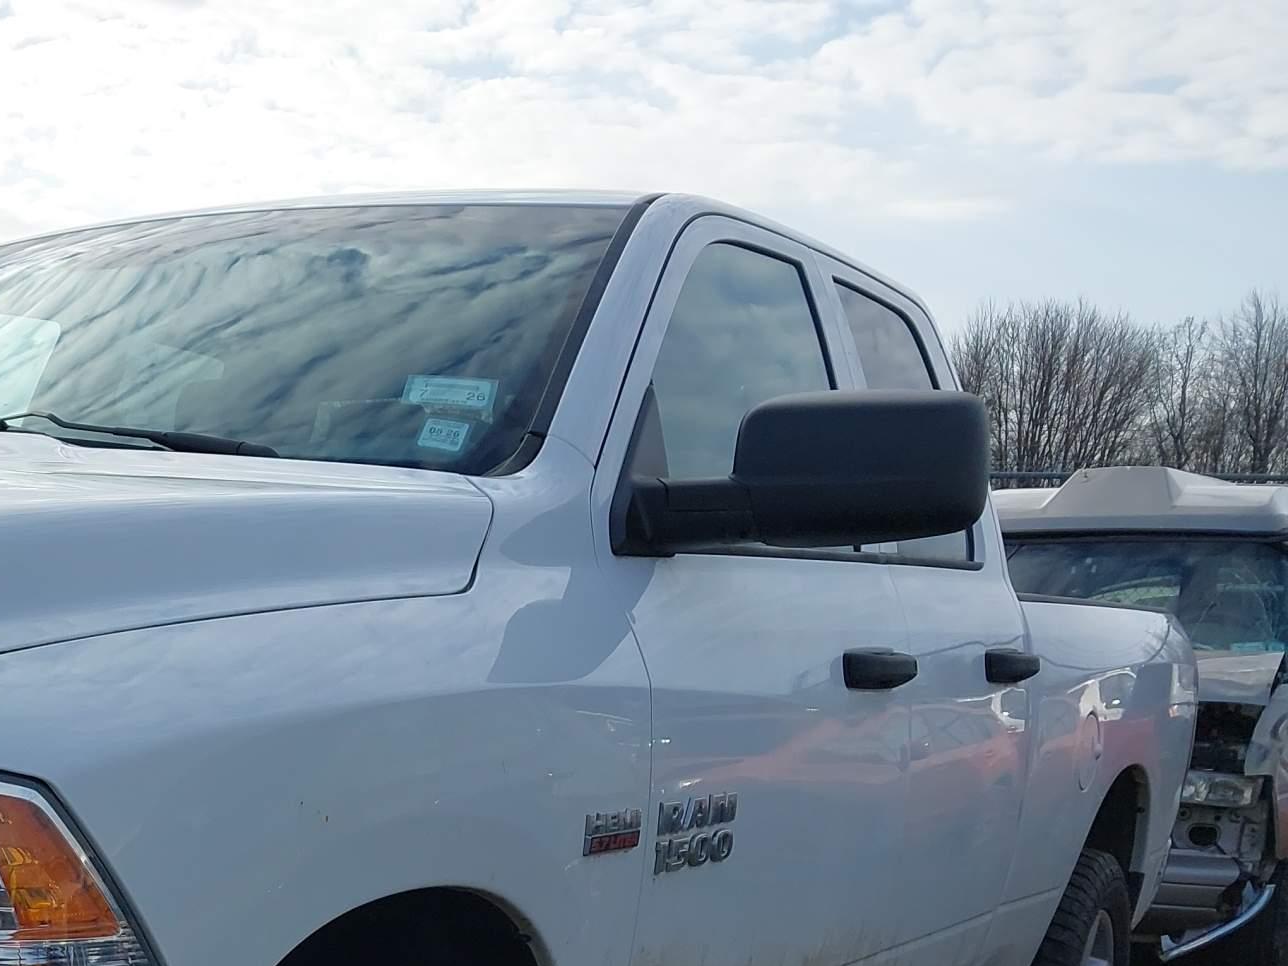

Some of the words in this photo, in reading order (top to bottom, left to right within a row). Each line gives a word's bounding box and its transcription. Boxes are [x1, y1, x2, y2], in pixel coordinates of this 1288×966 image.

[584, 808, 642, 836] HEMI
[656, 792, 738, 836] RAM
[654, 828, 733, 875] 1500
